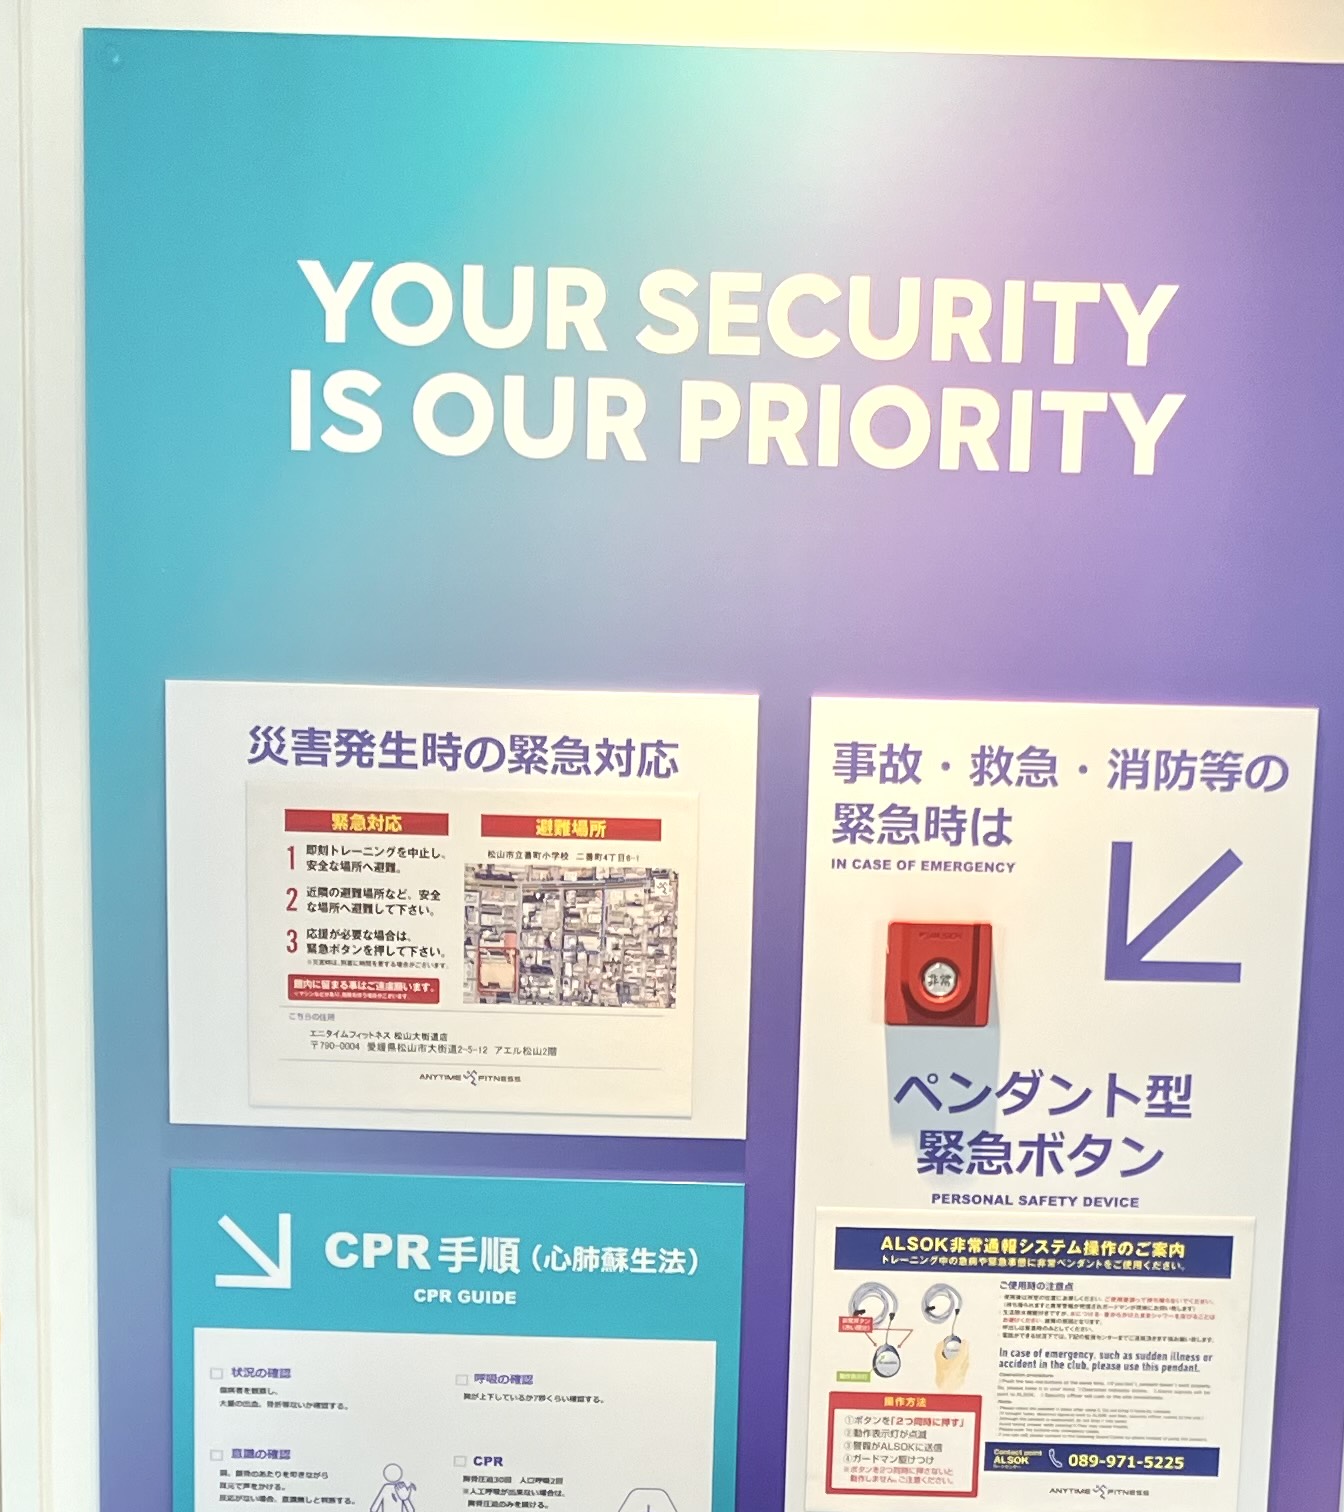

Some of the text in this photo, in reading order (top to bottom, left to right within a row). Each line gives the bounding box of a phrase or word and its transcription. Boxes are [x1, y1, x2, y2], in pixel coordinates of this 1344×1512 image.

[297, 258, 1179, 367] YOUR SECURITY
[289, 368, 1187, 476] IS OUR PRIORITY
[247, 724, 680, 779] 災害発生時の緊急対応
[832, 741, 1289, 793] 事故・救急・消防等の
[331, 813, 402, 832] 緊急対応
[536, 819, 606, 838] 避難場所
[831, 802, 1014, 847] 緊急時は
[287, 846, 295, 870] 1
[306, 861, 401, 874] 安全な場所へ避難。
[831, 859, 1016, 874] IN CASE OF EMERGENCY
[286, 888, 298, 911] 2
[287, 930, 298, 954] 3
[310, 1030, 448, 1041] エニタイムフィットネス 松山大街道店
[419, 1073, 521, 1083] ANYTIME FITNESS
[893, 1070, 1193, 1120] ペンダント型
[916, 1130, 1165, 1179] 緊急ボタン
[931, 1193, 1140, 1209] PERSONAL SAFETY DEVICE
[414, 1288, 517, 1306] CPR GUIDE
[999, 1348, 1008, 1357] In
[1010, 1350, 1030, 1358] case
[1033, 1349, 1042, 1358] of
[1099, 1351, 1120, 1360] such
[1123, 1352, 1133, 1360] as
[1136, 1352, 1167, 1361] sudden
[1170, 1352, 1199, 1362] illness
[1203, 1354, 1212, 1362] or
[999, 1359, 1036, 1368] accident
[1040, 1360, 1047, 1369] in
[1051, 1360, 1065, 1369] the
[1092, 1361, 1121, 1372] please
[1124, 1362, 1139, 1371] use
[1142, 1361, 1159, 1371] this
[474, 1374, 533, 1385] 呼吸の確認
[473, 1456, 504, 1467] CPR
[994, 1454, 1184, 1469] ALSOK 089-971-5225
